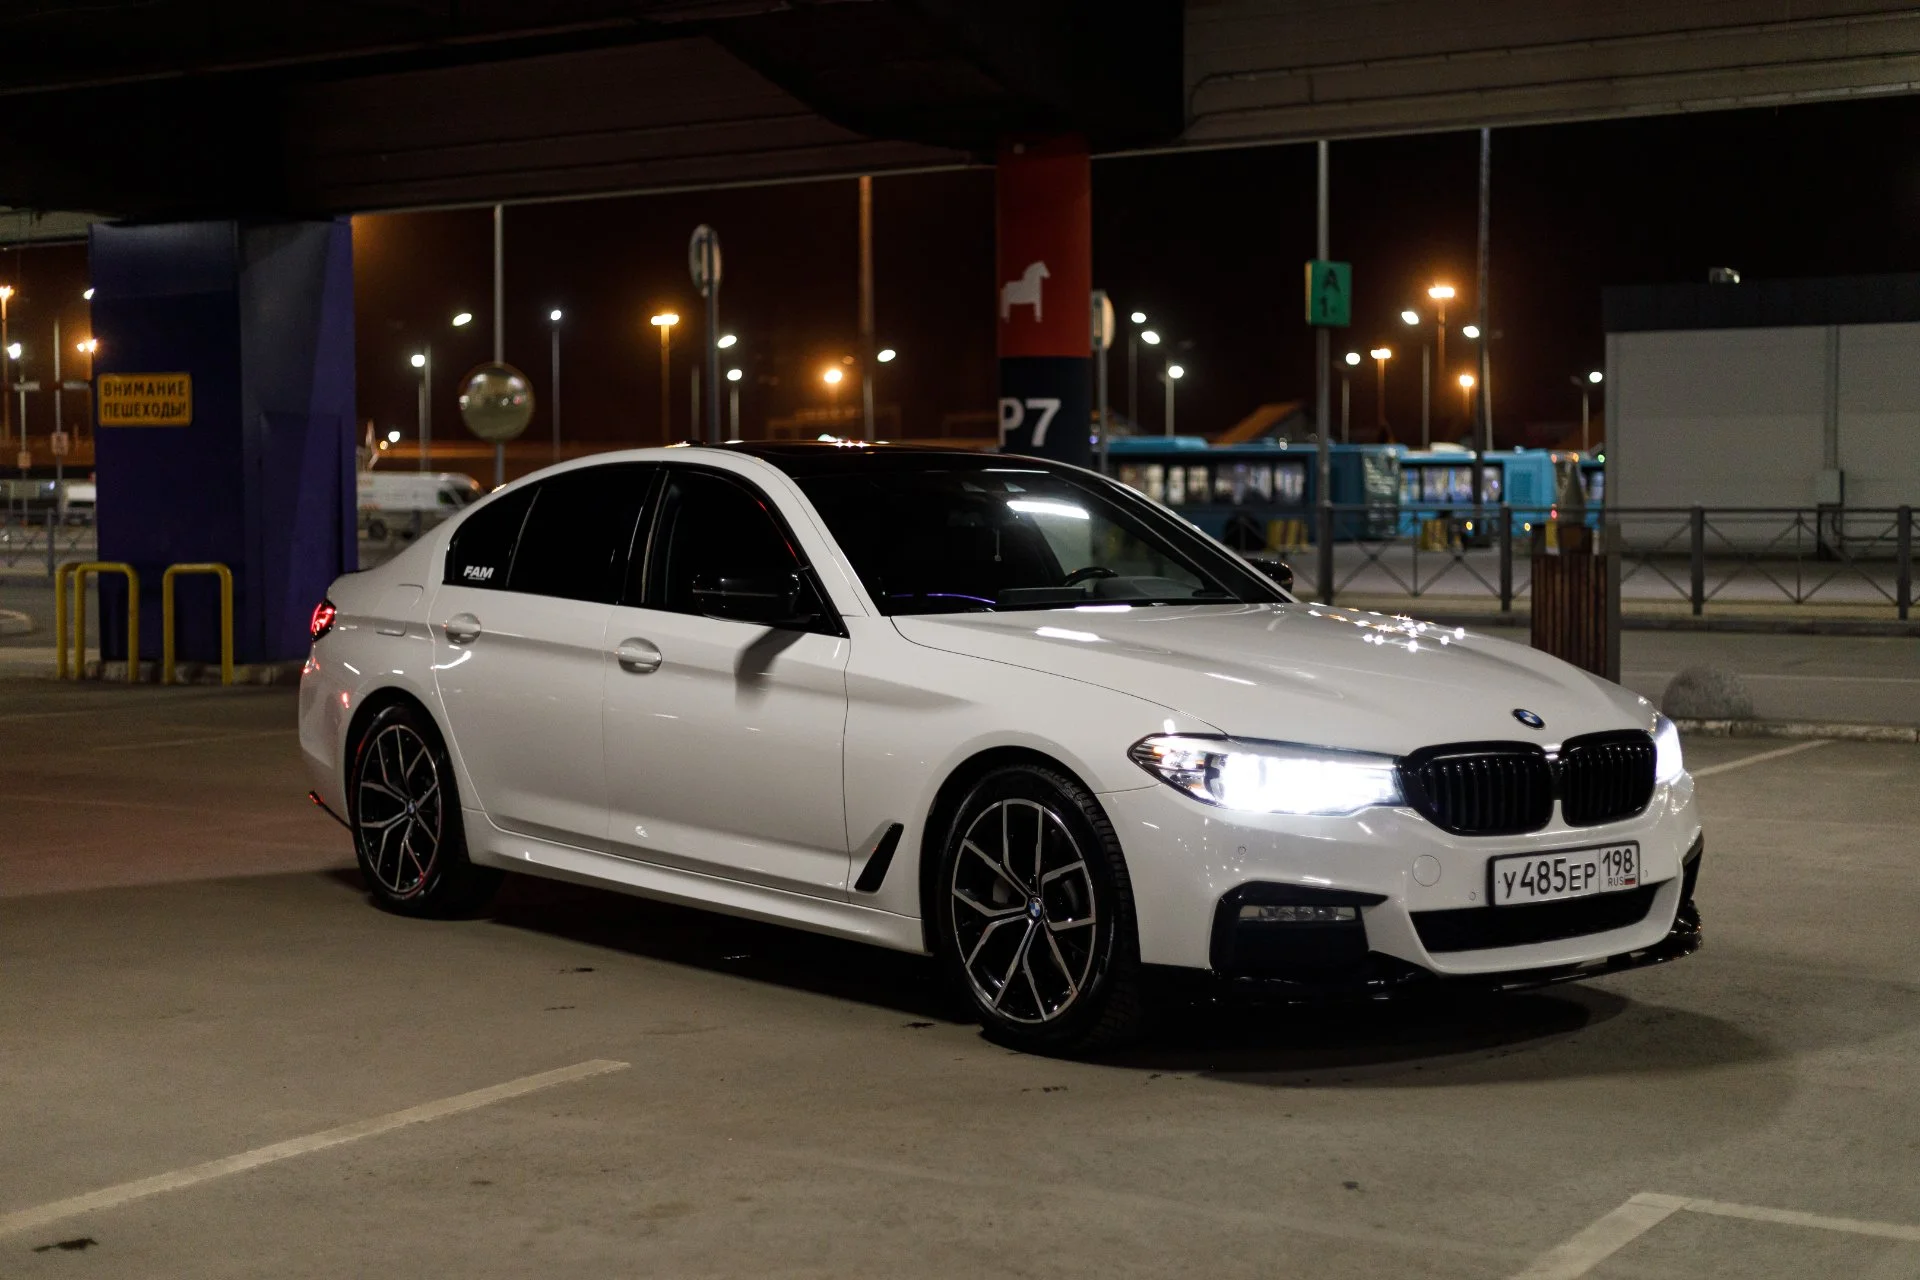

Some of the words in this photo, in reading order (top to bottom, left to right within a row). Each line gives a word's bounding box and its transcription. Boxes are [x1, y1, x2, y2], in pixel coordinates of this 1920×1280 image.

[103, 381, 186, 397] ВНИМАНИЕ
[103, 401, 187, 419] ПЕШЕХОДЫ!
[998, 397, 1061, 448] P7
[463, 565, 494, 579] FAM
[1602, 848, 1633, 877] 198
[1607, 877, 1624, 887] RUS
